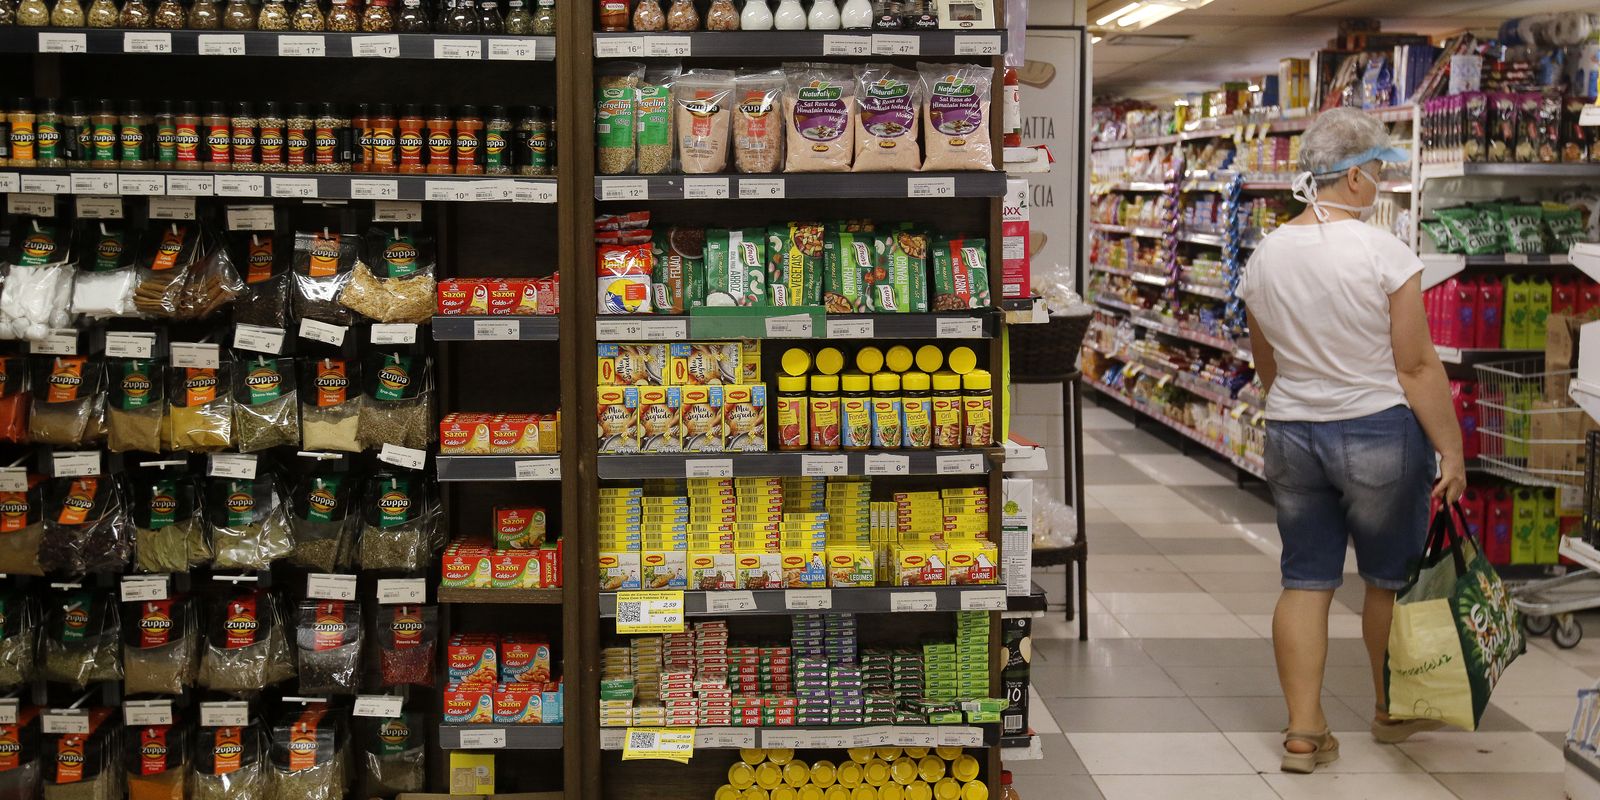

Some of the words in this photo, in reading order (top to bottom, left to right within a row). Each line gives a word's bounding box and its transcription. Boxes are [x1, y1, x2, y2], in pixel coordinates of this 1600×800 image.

[637, 100, 666, 110] ergelim
[1020, 117, 1055, 138] ATTA
[1029, 184, 1054, 207] CIA
